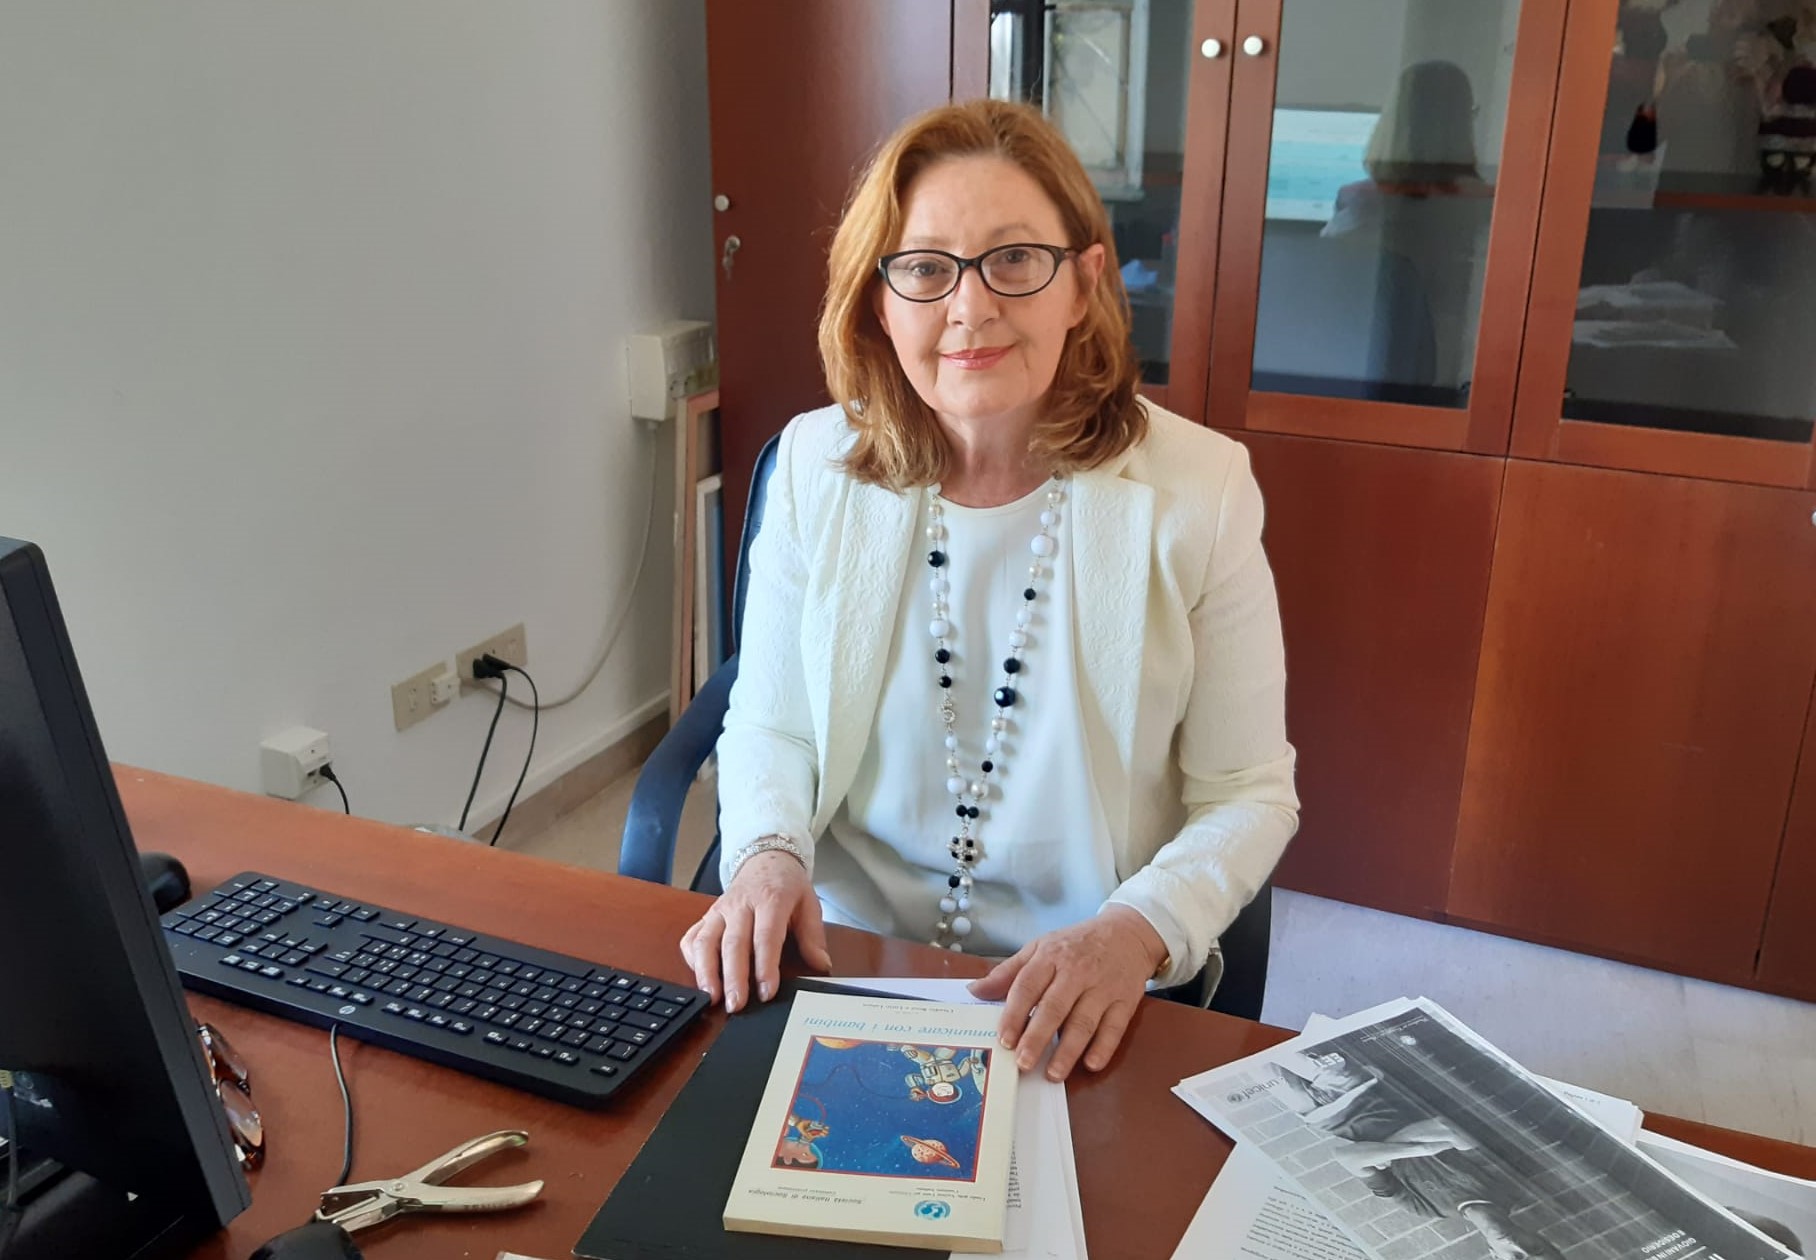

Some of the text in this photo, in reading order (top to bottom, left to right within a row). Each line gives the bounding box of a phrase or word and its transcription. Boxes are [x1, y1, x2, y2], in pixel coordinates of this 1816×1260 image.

[804, 1017, 866, 1032] bambini
[883, 1024, 912, 1034] con
[918, 1025, 998, 1039] omunicare
[1241, 1079, 1280, 1099] unicef
